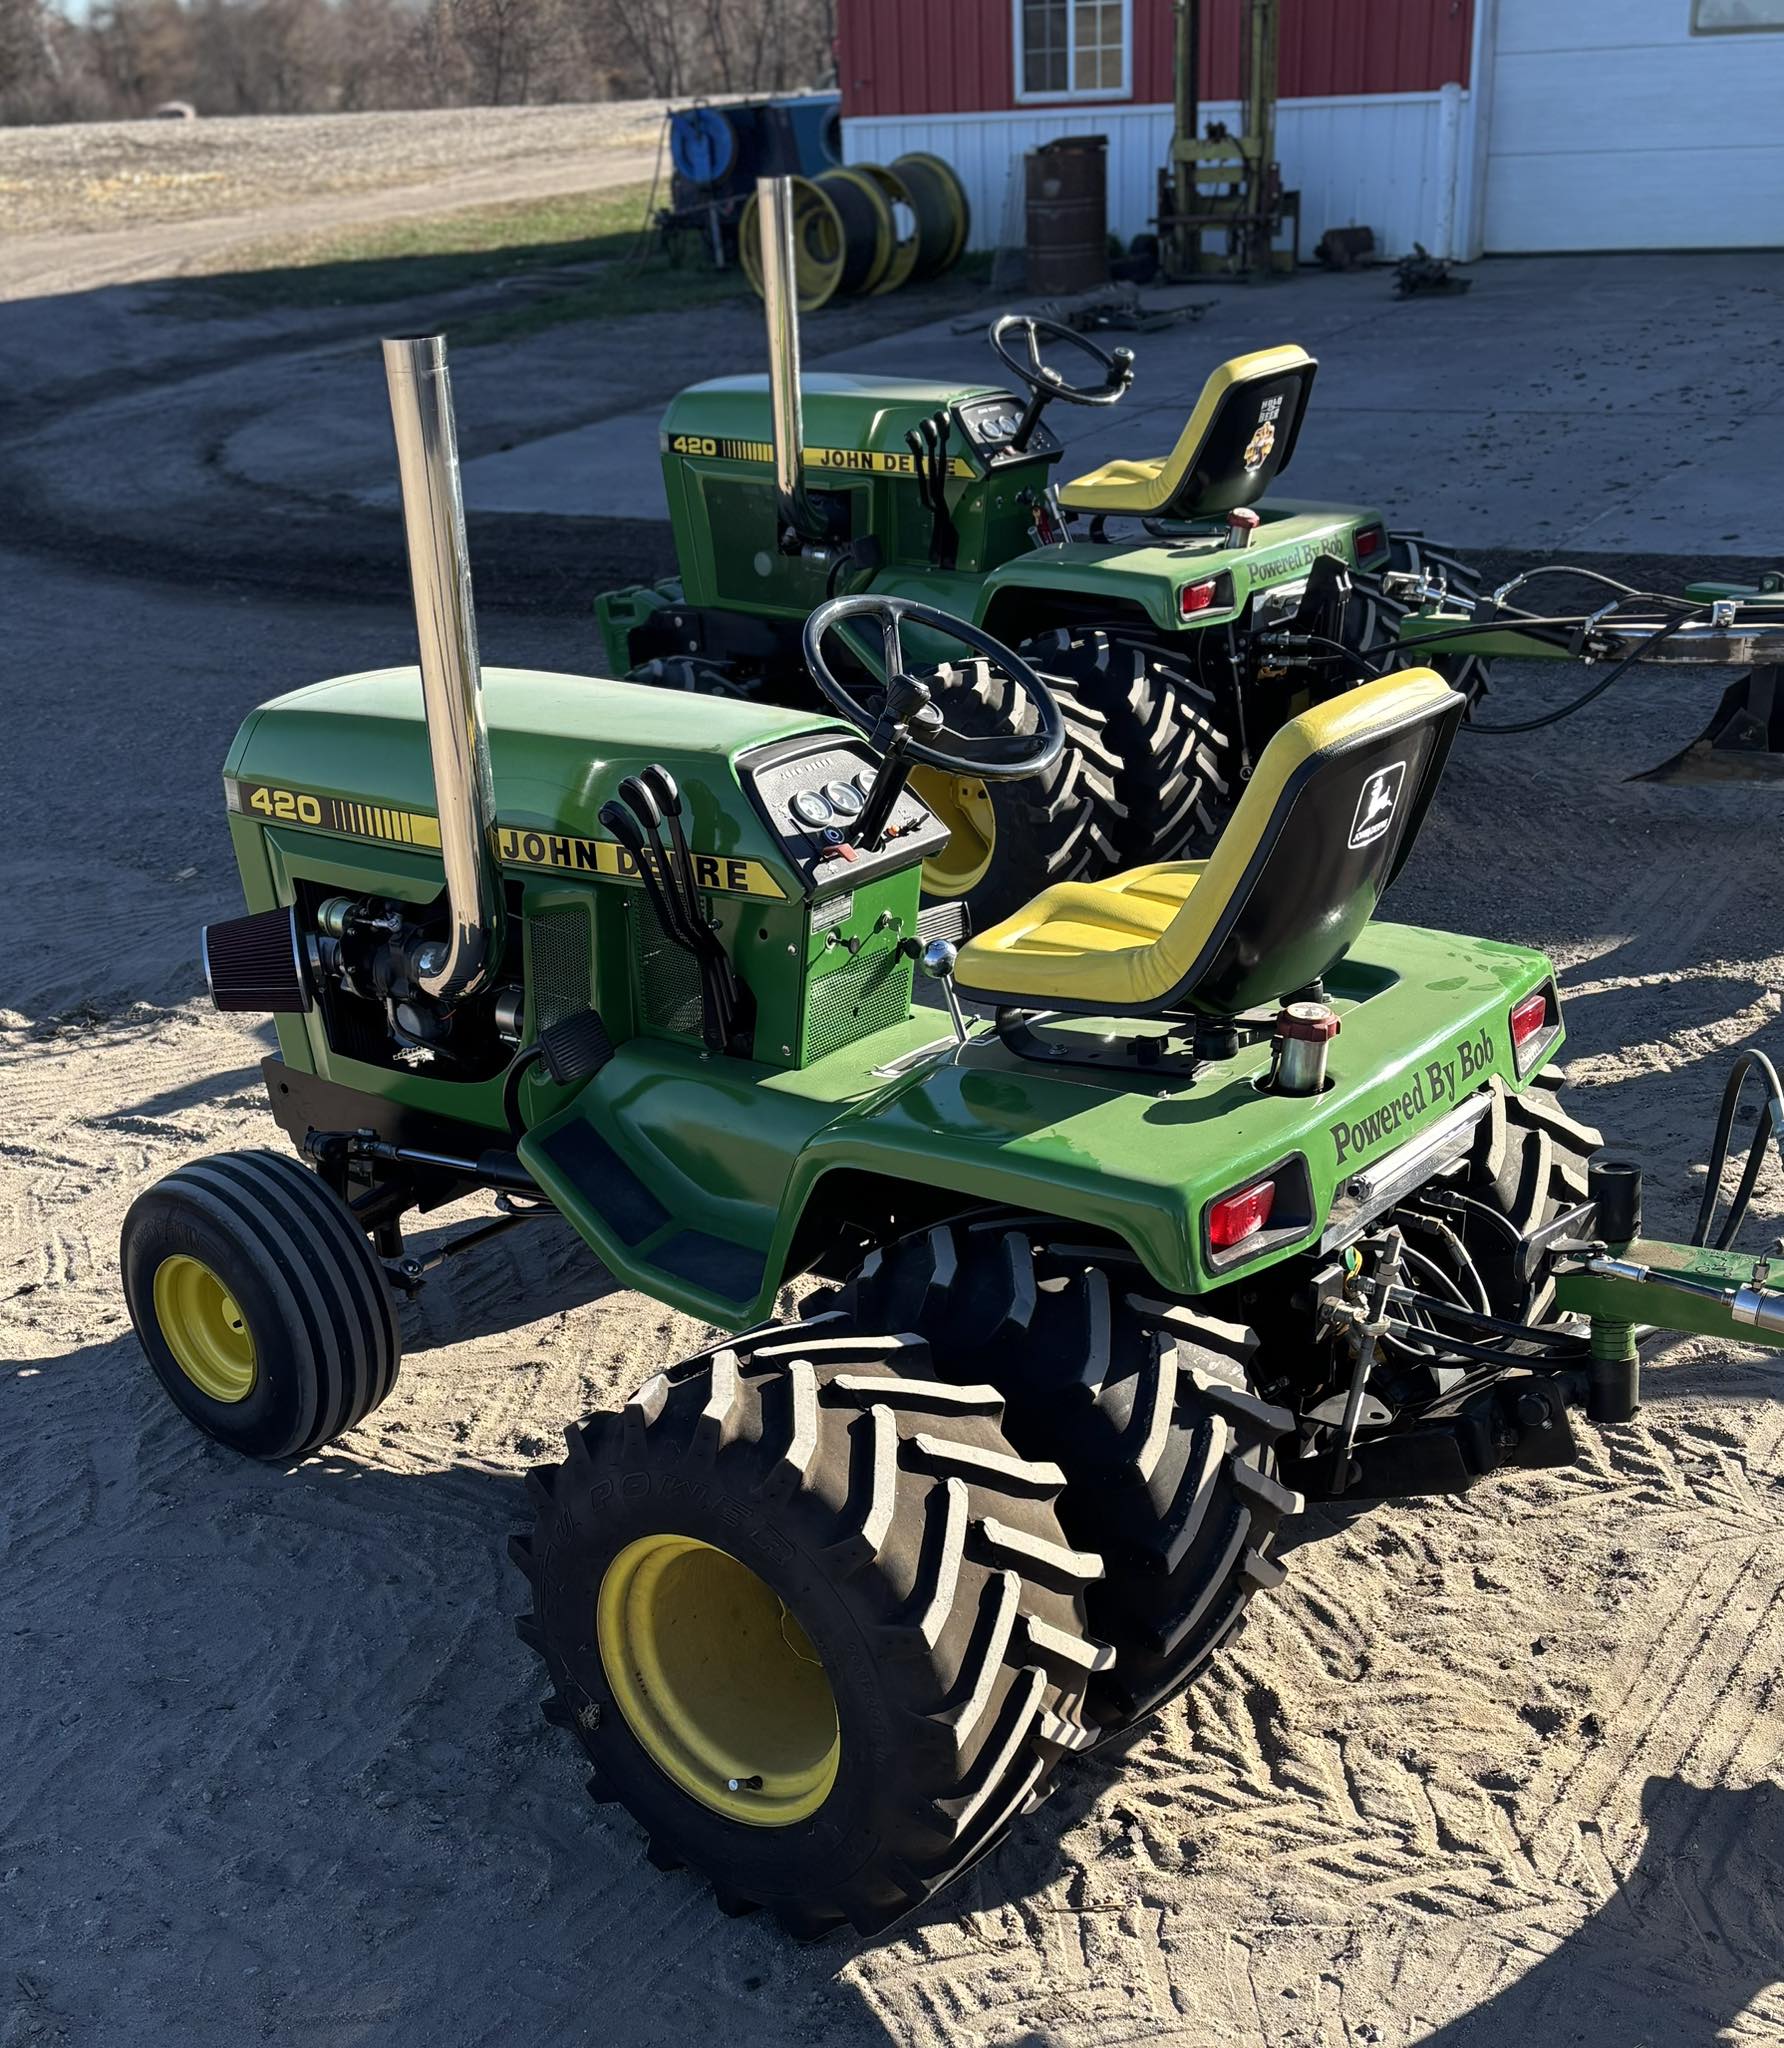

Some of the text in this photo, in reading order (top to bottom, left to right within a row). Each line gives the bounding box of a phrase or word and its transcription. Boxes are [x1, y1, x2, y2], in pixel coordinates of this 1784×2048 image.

[673, 435, 717, 456] 420
[820, 450, 956, 475] JOHN DEE
[1246, 534, 1343, 585] Powered By Bob
[250, 787, 322, 825] 420
[503, 831, 599, 871] JOHN
[1329, 1072, 1428, 1166] Powered
[1425, 1061, 1456, 1102] By
[1456, 1027, 1494, 1081] Bob
[590, 1471, 797, 1566] POWER
